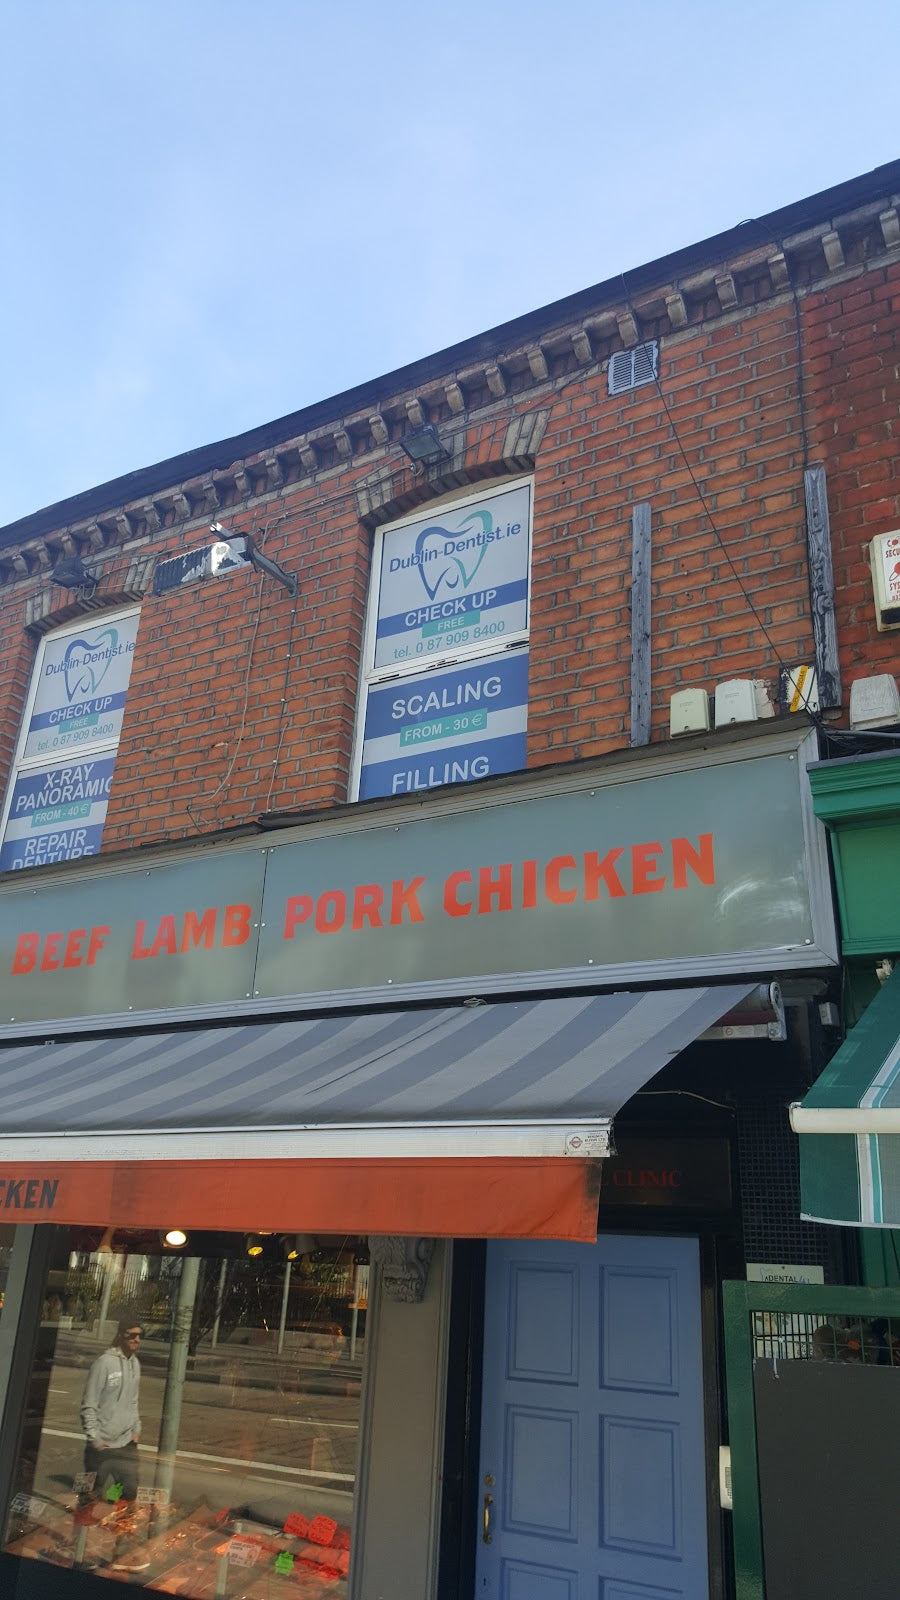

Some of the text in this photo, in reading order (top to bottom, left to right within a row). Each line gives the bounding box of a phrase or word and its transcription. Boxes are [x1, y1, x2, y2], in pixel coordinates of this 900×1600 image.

[389, 523, 521, 572] Dublin-Dentist.ie
[405, 590, 497, 626] CHECK UP
[437, 616, 465, 631] FREE
[394, 620, 505, 659] tel. 0 87 909 8400
[45, 641, 136, 676] Dublin-Dentist.ie
[49, 696, 113, 724] CHECK UP
[391, 676, 502, 719] SCALING
[37, 723, 114, 750] tel. 0 87 909 8400
[69, 717, 89, 729] FREE
[404, 723, 442, 741] FROM
[453, 718, 469, 731] 30
[471, 713, 483, 726] €
[43, 763, 95, 790] X-RAY
[391, 756, 489, 794] FILLING
[34, 809, 61, 823] FROM
[67, 806, 79, 816] 40
[81, 803, 89, 814] €
[24, 829, 87, 857] REPAIR
[11, 832, 716, 975] BEEF LAMB PORK CHICKEN
[613, 1169, 683, 1187] CLINIC
